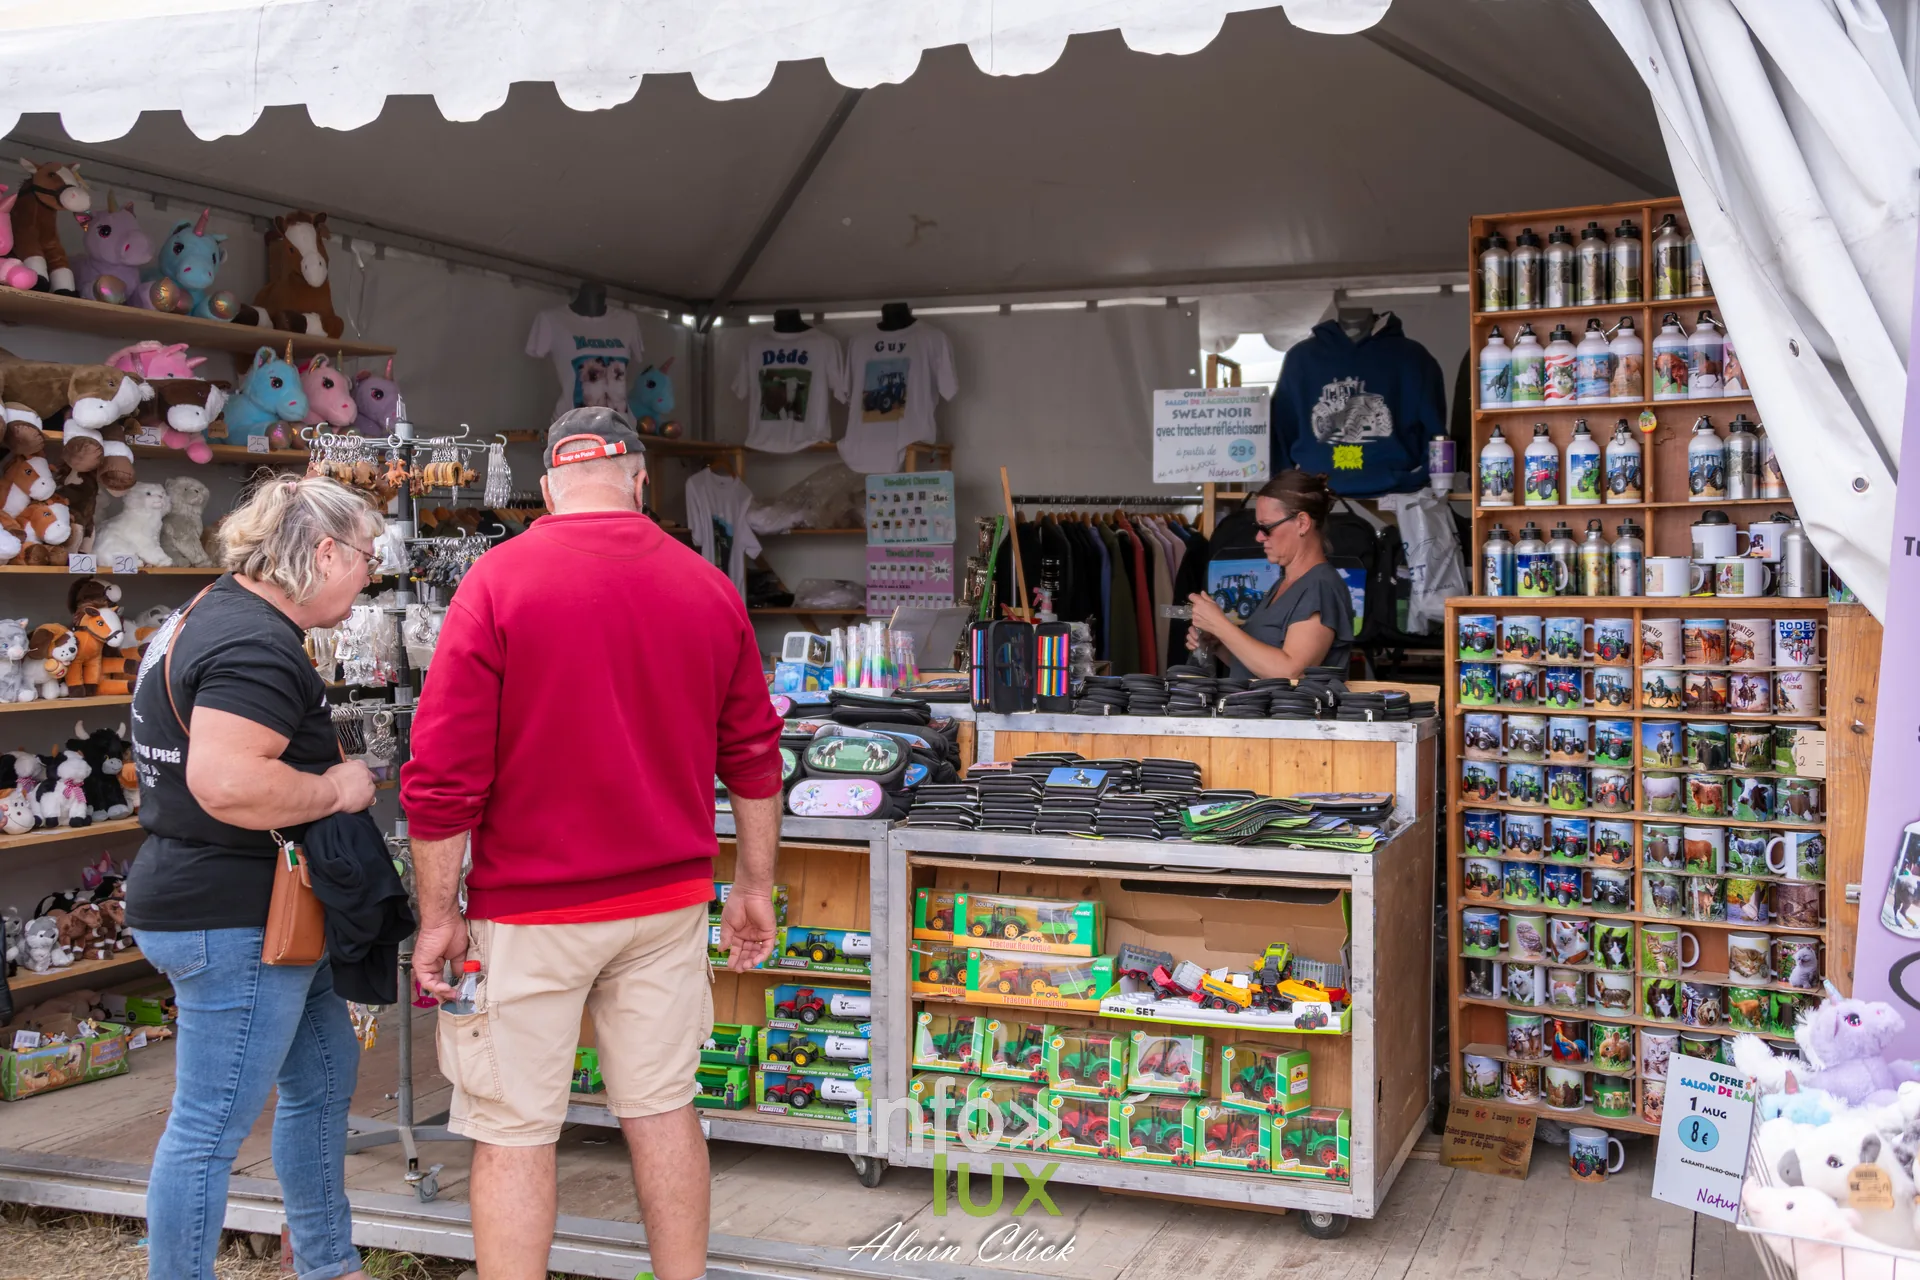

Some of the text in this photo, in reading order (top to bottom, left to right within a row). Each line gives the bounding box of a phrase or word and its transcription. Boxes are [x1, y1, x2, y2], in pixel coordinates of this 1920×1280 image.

[573, 334, 625, 350] Manon
[874, 340, 907, 354] Guy
[762, 349, 809, 366] Dédé
[1172, 407, 1252, 419] SWEAT NOIR
[1156, 426, 1175, 437] avec
[1231, 446, 1246, 457] 29
[1208, 467, 1240, 478] Nature
[1779, 621, 1817, 631] RODEO
[1797, 755, 1806, 767] 2
[989, 939, 1052, 953] Tracteur Remorque
[942, 985, 966, 997] Tracteu
[1002, 995, 1068, 1008] Tracteur Remorque
[1135, 1007, 1155, 1016] SET
[1709, 1071, 1743, 1089] OFFRE
[1680, 1077, 1717, 1094] SALON
[1717, 1085, 1732, 1098] DE
[1456, 1107, 1469, 1117] mug
[1690, 1096, 1727, 1119] 1 MUG
[1691, 1121, 1700, 1143] 8
[1681, 1157, 1704, 1169] GARANTI
[1705, 1165, 1740, 1179] MICRO-ONDE
